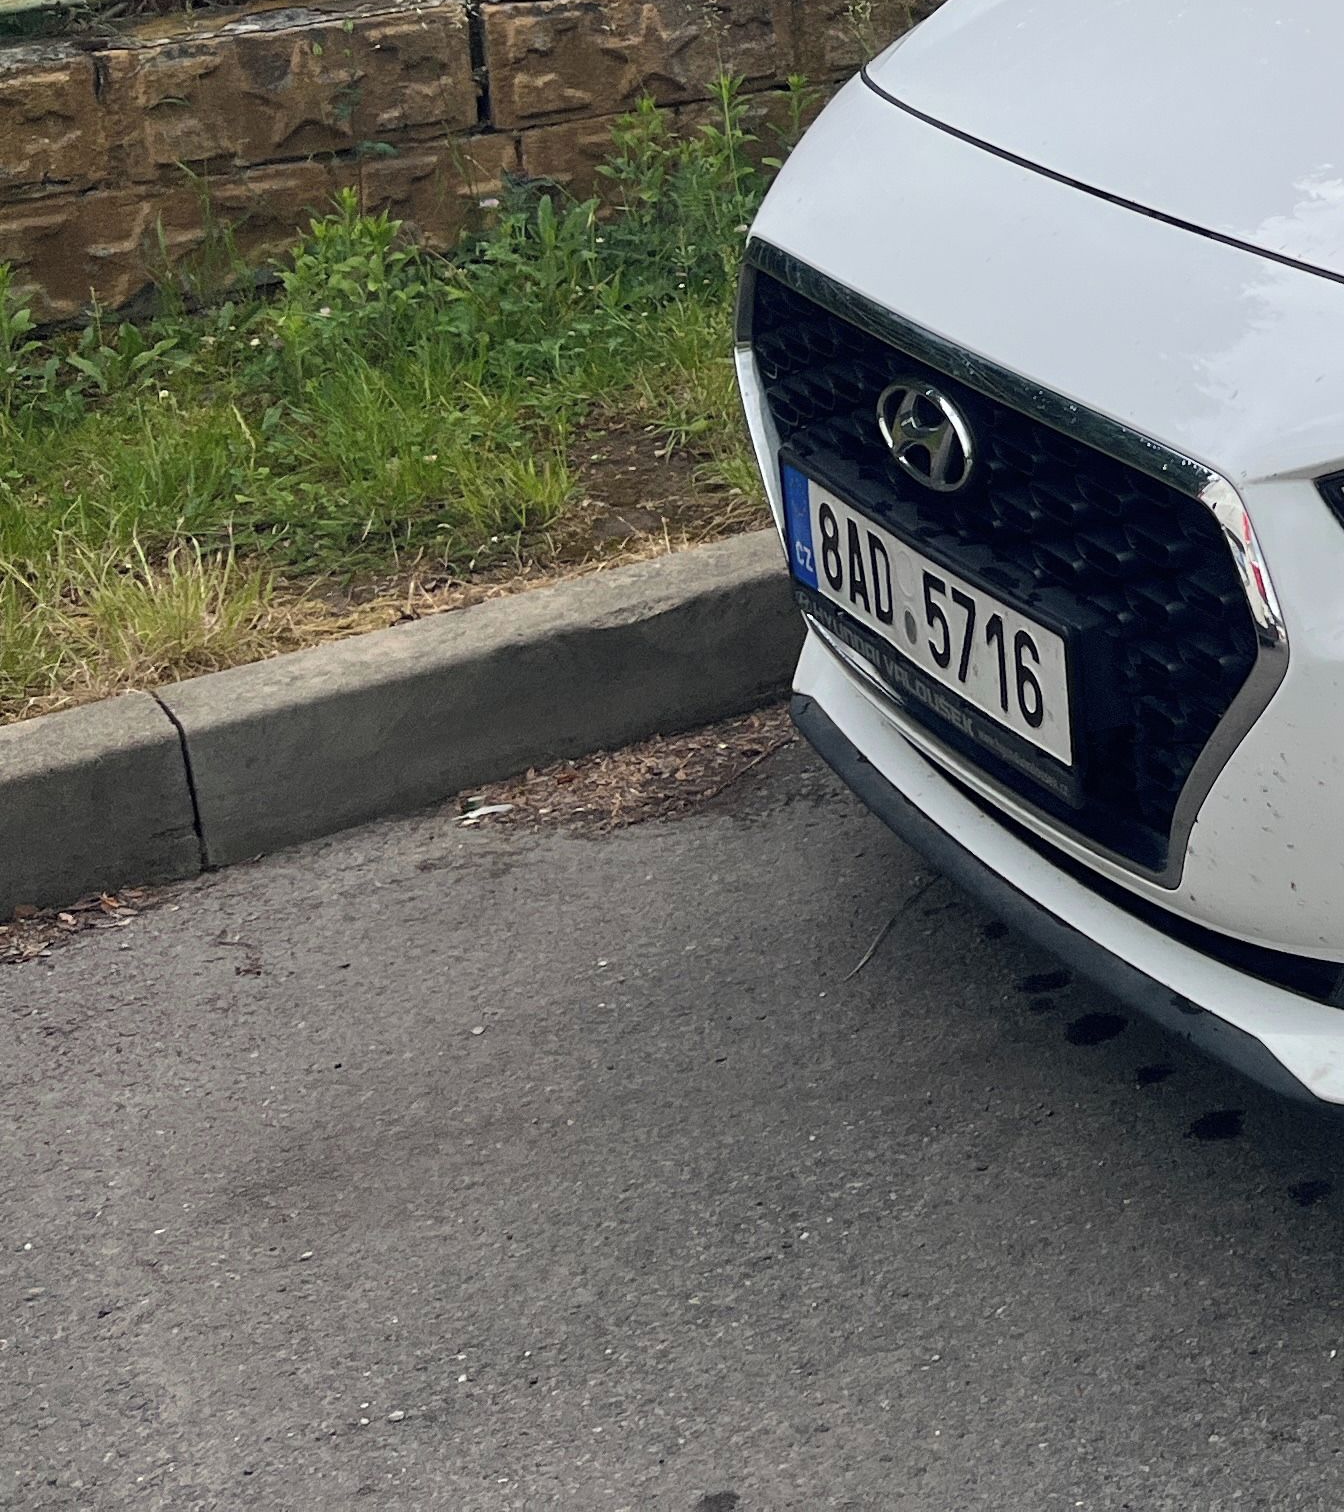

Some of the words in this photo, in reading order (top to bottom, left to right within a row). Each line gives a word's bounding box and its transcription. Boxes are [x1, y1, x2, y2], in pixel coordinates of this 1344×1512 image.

[795, 540, 814, 573] CZ
[819, 502, 893, 625] 8AD
[922, 568, 1044, 729] 5716
